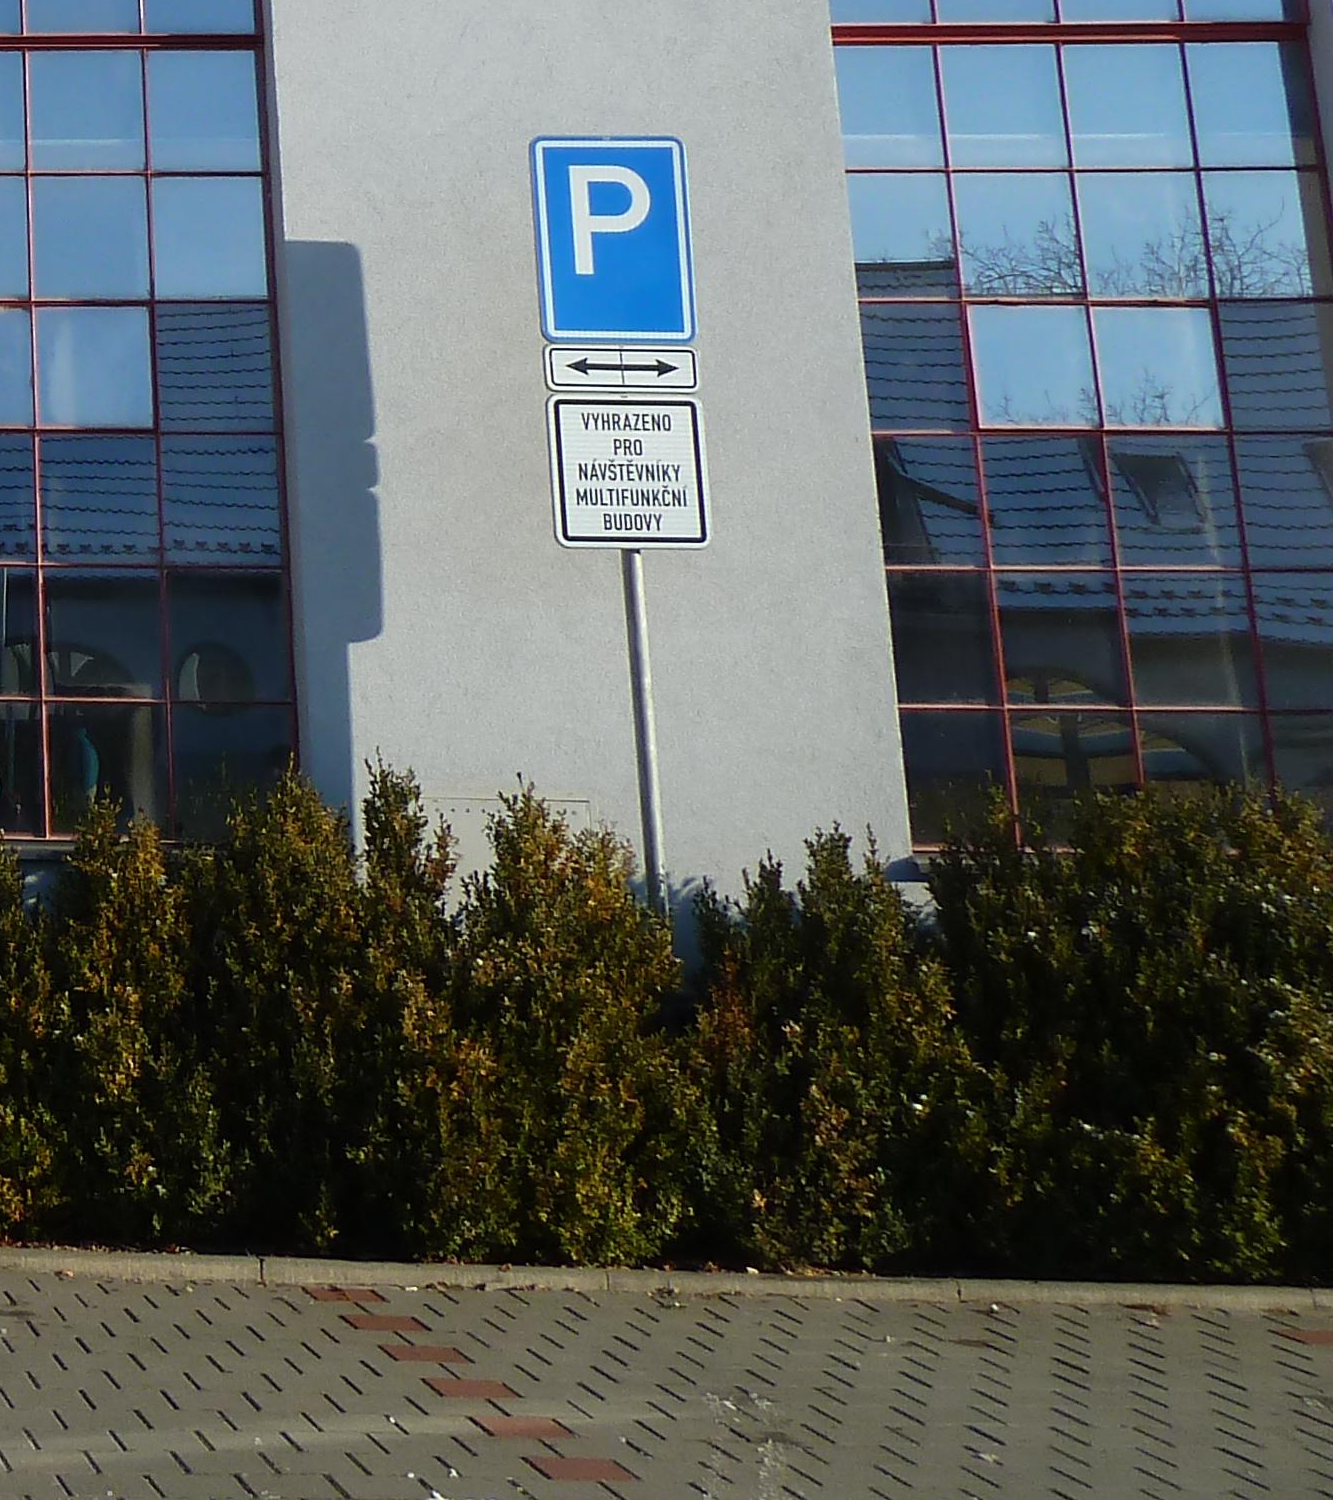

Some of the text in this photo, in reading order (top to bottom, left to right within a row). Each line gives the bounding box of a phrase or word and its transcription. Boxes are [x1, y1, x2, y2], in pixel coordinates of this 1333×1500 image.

[568, 164, 651, 275] P
[580, 412, 672, 432] VYHRAZENO
[613, 438, 643, 456] PRO
[578, 458, 681, 482] NÁVŠTĚVNÍKY
[575, 485, 688, 508] MULTIFUNKČNÍ
[602, 513, 663, 532] BUDOVY
